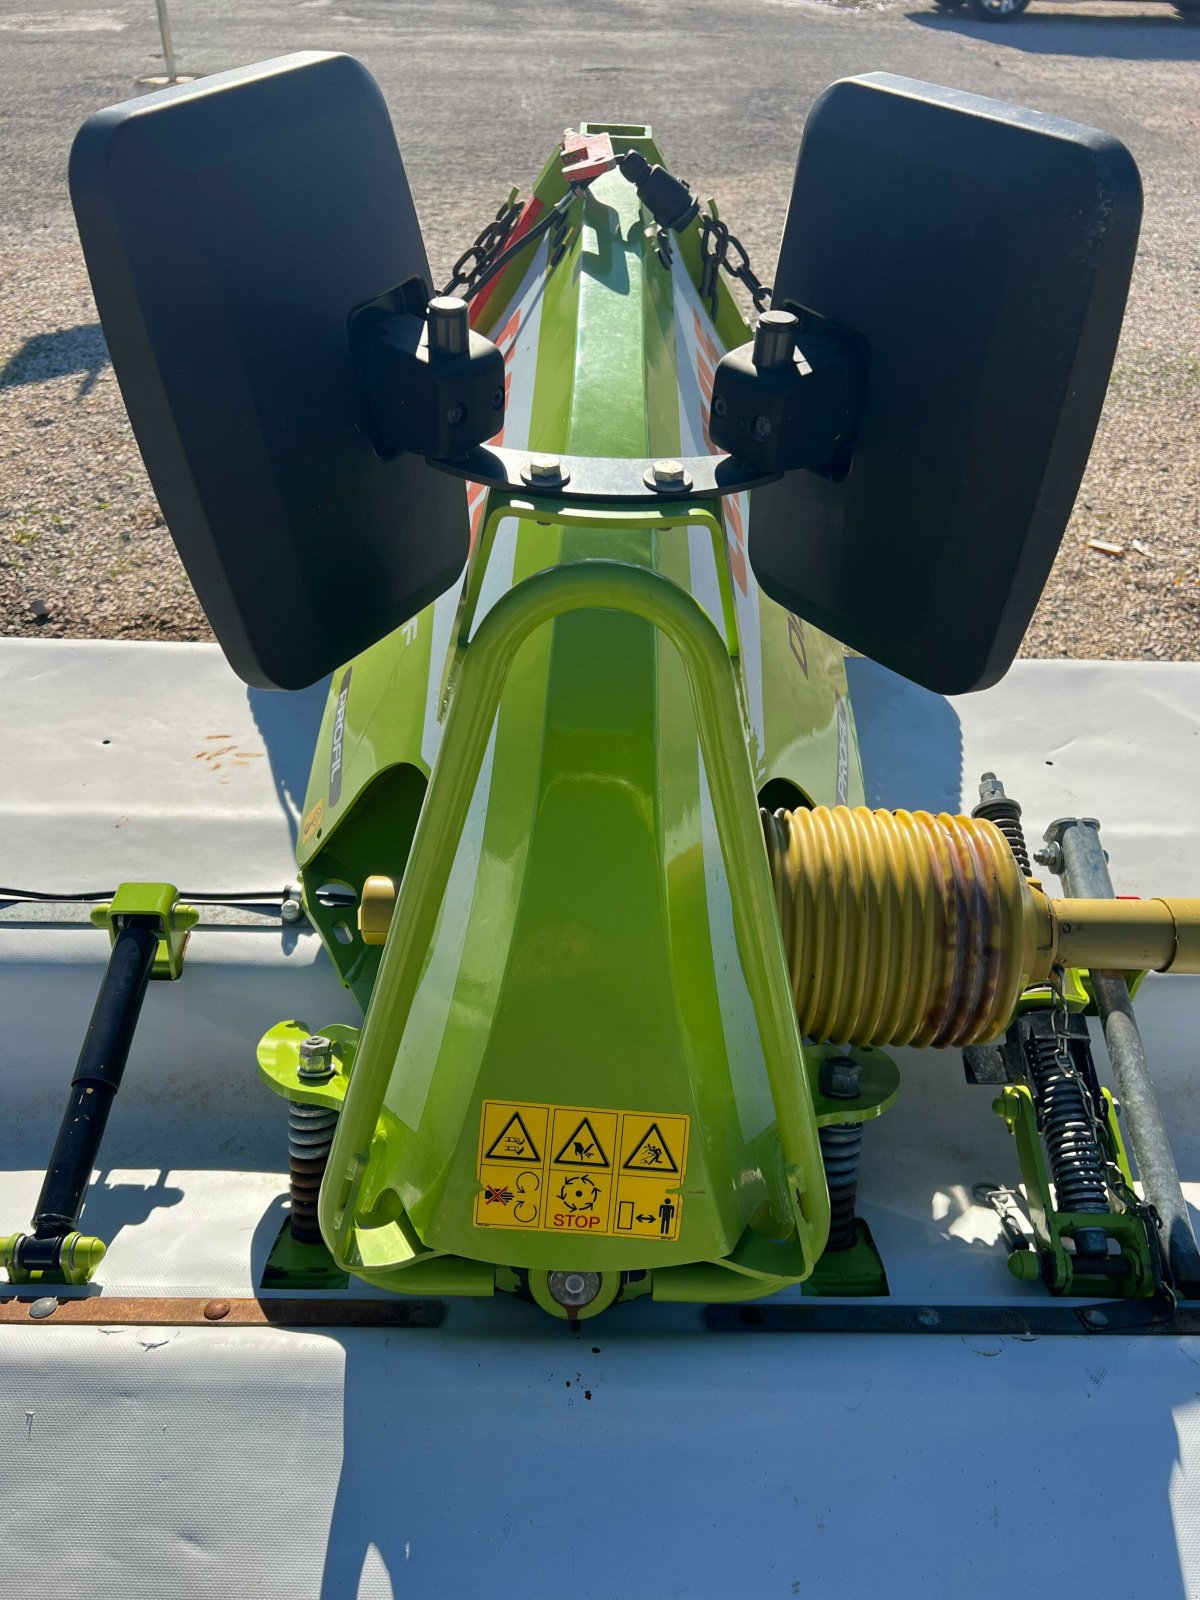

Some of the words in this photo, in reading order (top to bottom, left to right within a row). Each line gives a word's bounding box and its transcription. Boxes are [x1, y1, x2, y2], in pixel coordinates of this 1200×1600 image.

[330, 688, 348, 783] PROFIL
[838, 715, 848, 804] PROFIL
[553, 1213, 601, 1229] STOP
